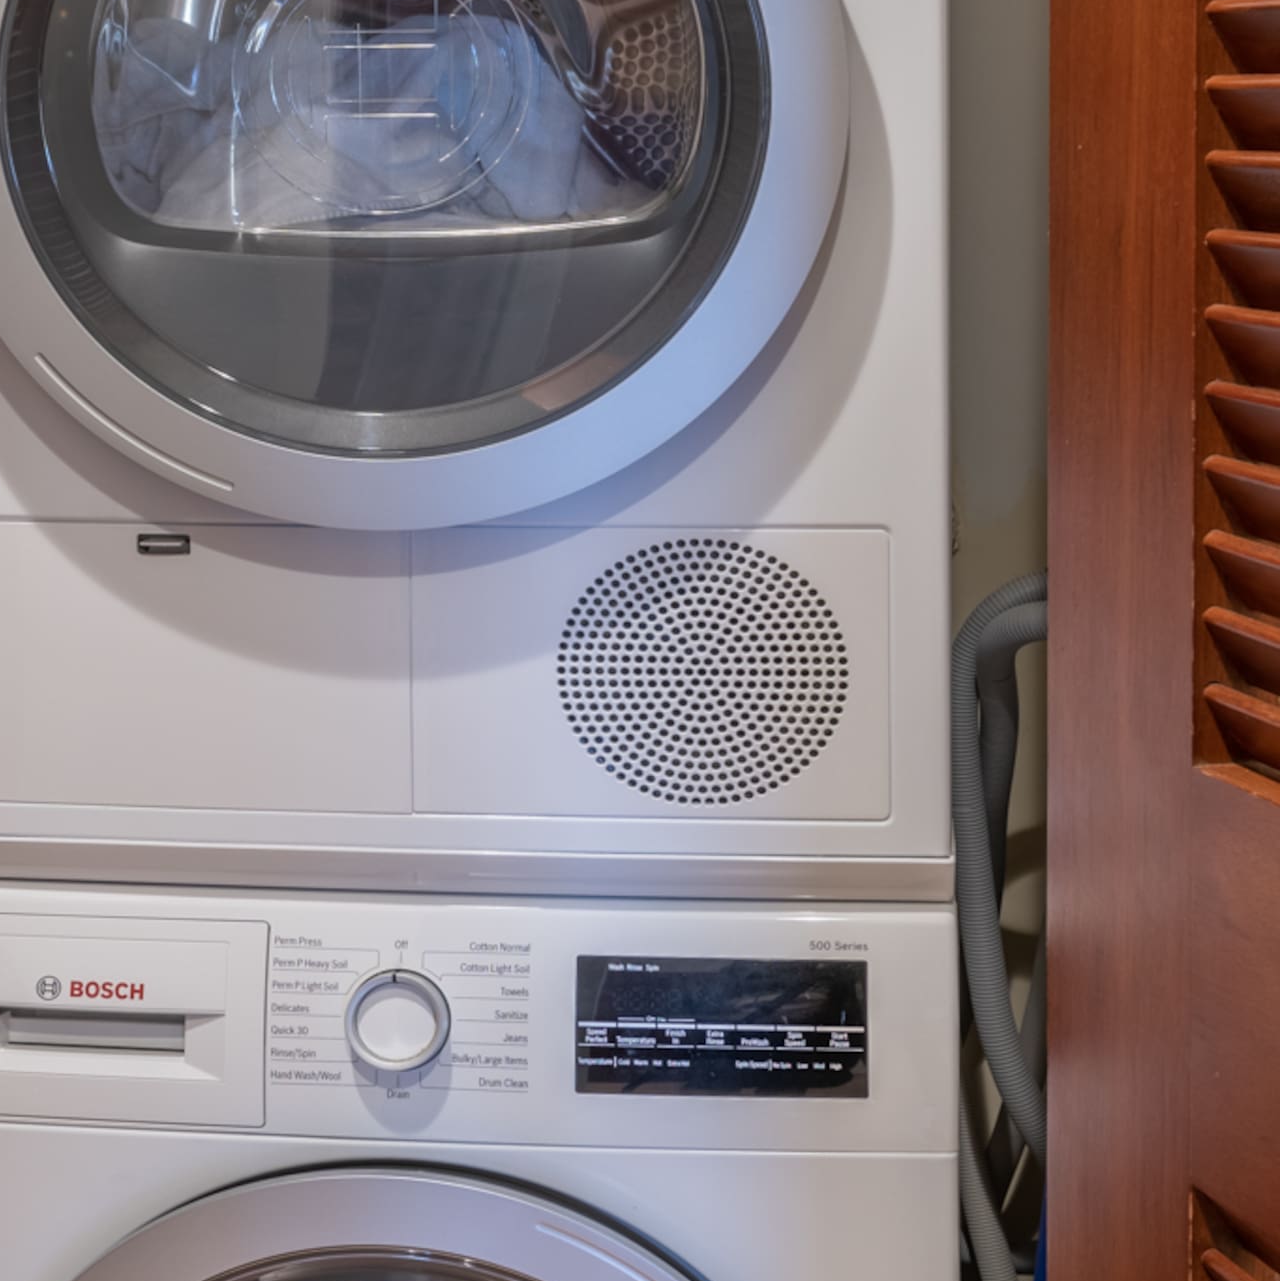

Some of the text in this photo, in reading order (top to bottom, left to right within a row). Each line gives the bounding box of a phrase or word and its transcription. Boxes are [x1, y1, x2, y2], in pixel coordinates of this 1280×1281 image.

[274, 935, 322, 946] Perm Press
[394, 939, 409, 950] Off
[809, 940, 868, 951] 500 Series
[469, 941, 531, 952] Cotton Normal
[273, 957, 296, 967] Perm
[331, 959, 348, 969] Soil
[460, 962, 531, 974] Cotton Light Soil
[70, 980, 144, 1000] BOSCH
[272, 980, 295, 990] Perm
[323, 981, 339, 991] Soil
[501, 986, 529, 997] Towels
[271, 1003, 310, 1013] Delicates
[494, 1009, 529, 1020] Sanitize
[271, 1025, 295, 1035] Quick
[503, 1033, 529, 1042] Jeans
[271, 1047, 317, 1059] Rinse/Spin
[271, 1070, 342, 1082] Hand Wash/Wool
[478, 1077, 529, 1088] Drum Clean
[387, 1087, 410, 1099] Drain
